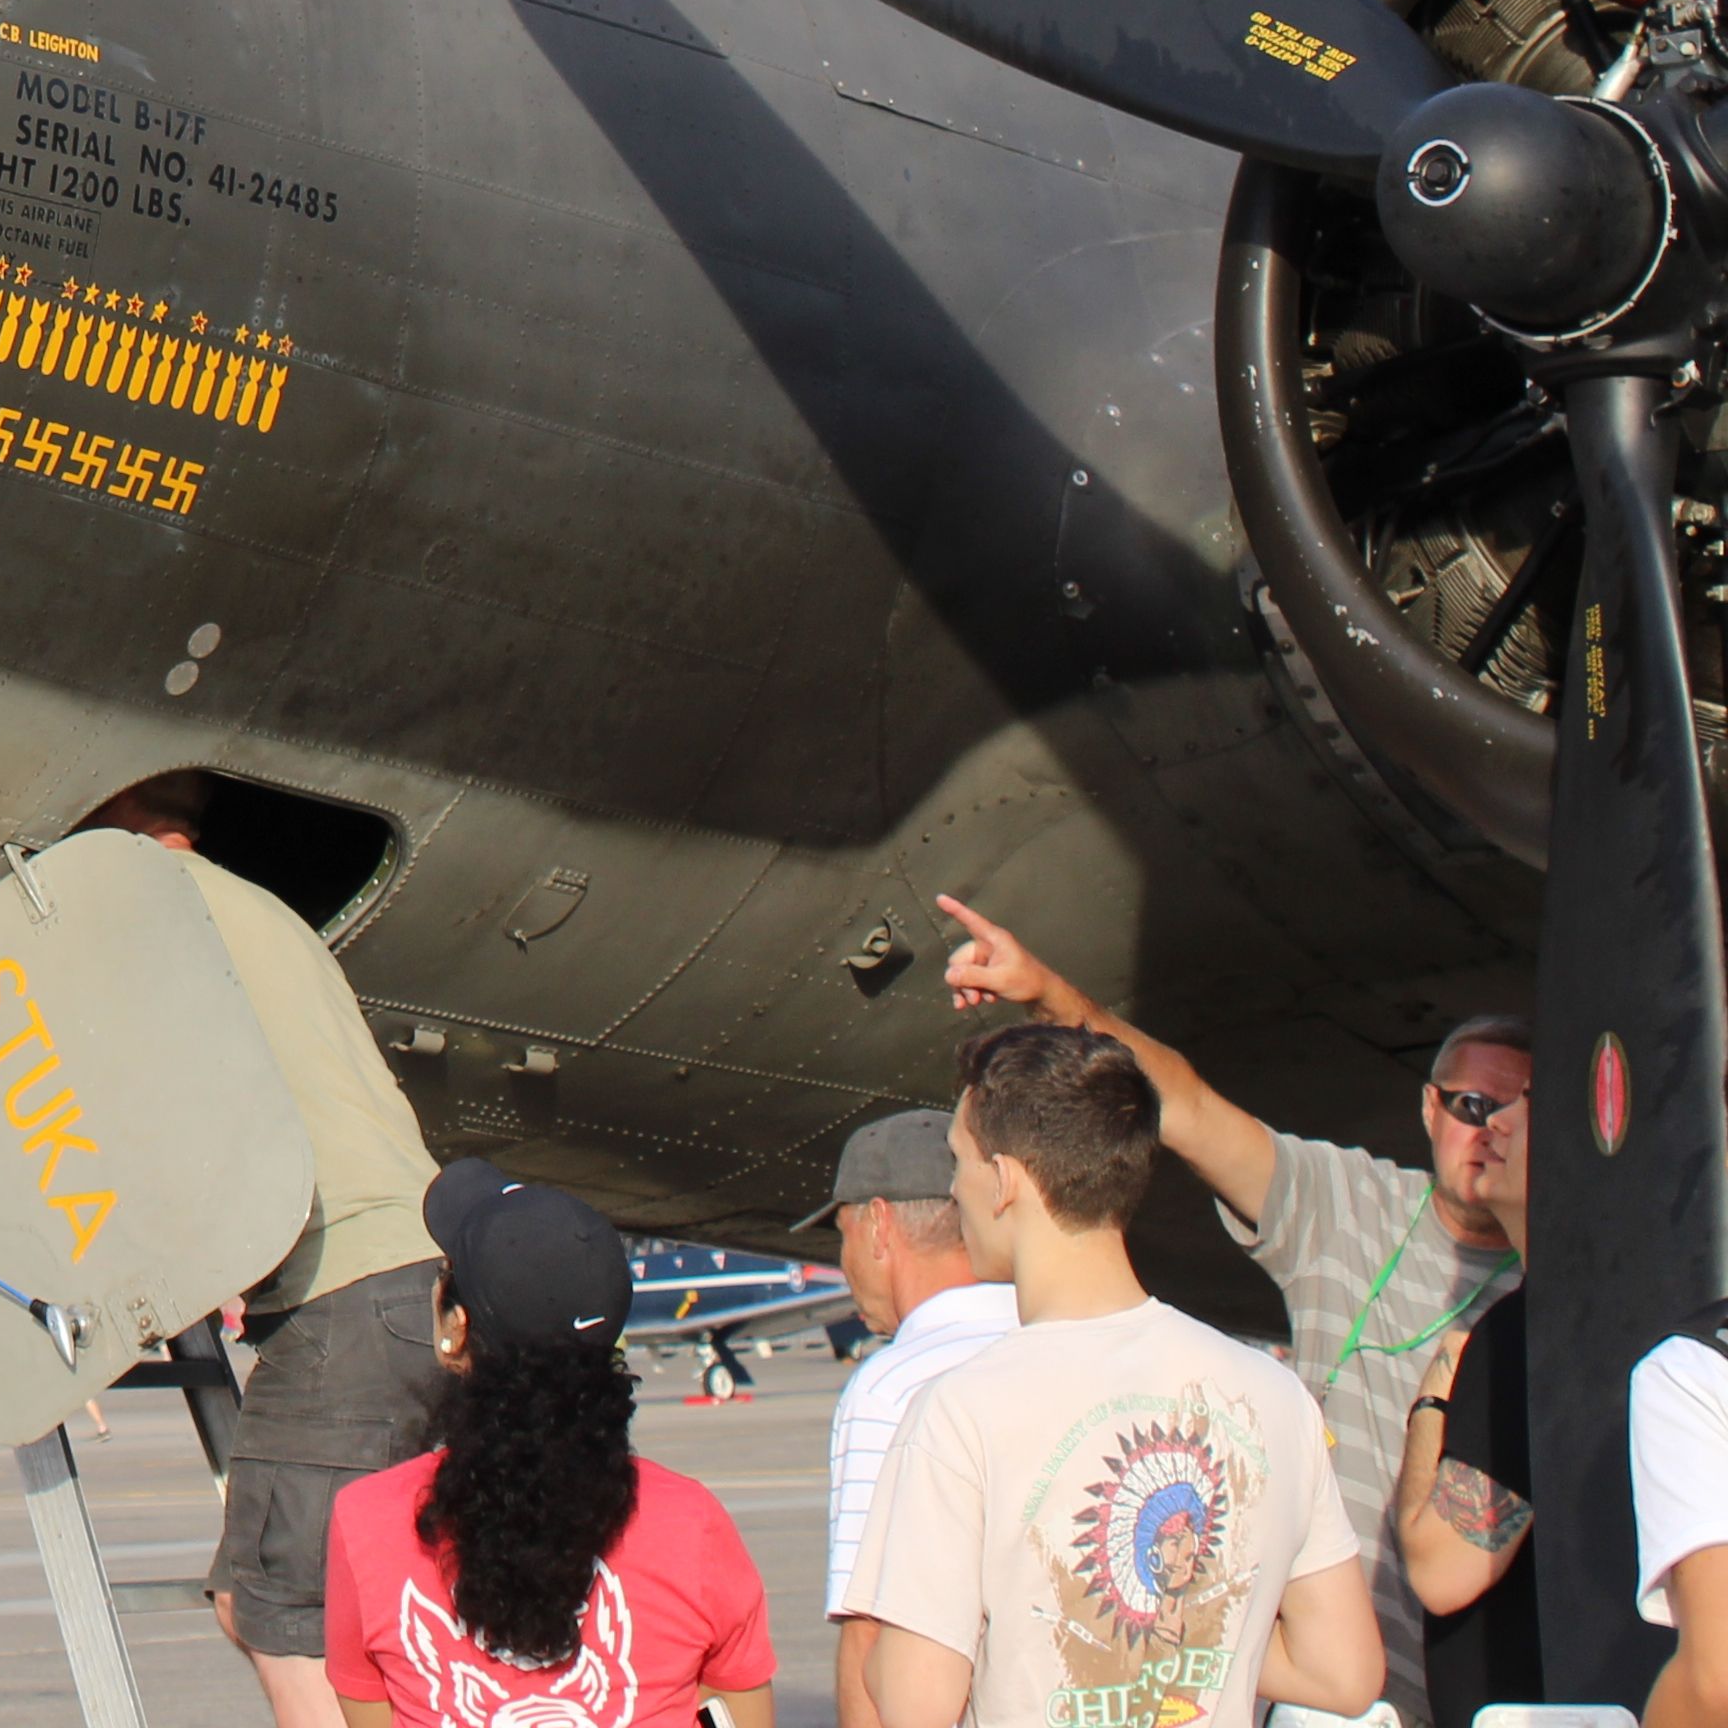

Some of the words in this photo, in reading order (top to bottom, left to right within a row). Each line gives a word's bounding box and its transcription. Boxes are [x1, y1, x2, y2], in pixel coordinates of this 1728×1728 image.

[29, 28, 99, 63] LEIGHTON
[16, 71, 121, 125] MODEL
[134, 99, 207, 146] B-17F
[15, 113, 117, 168] SERIAL
[138, 144, 194, 188] NO.
[208, 165, 340, 225] 41-24485
[20, 204, 93, 234] AIRPLANE
[49, 166, 119, 209] 1200
[133, 188, 192, 228] LBS.
[58, 237, 89, 259] FUEL
